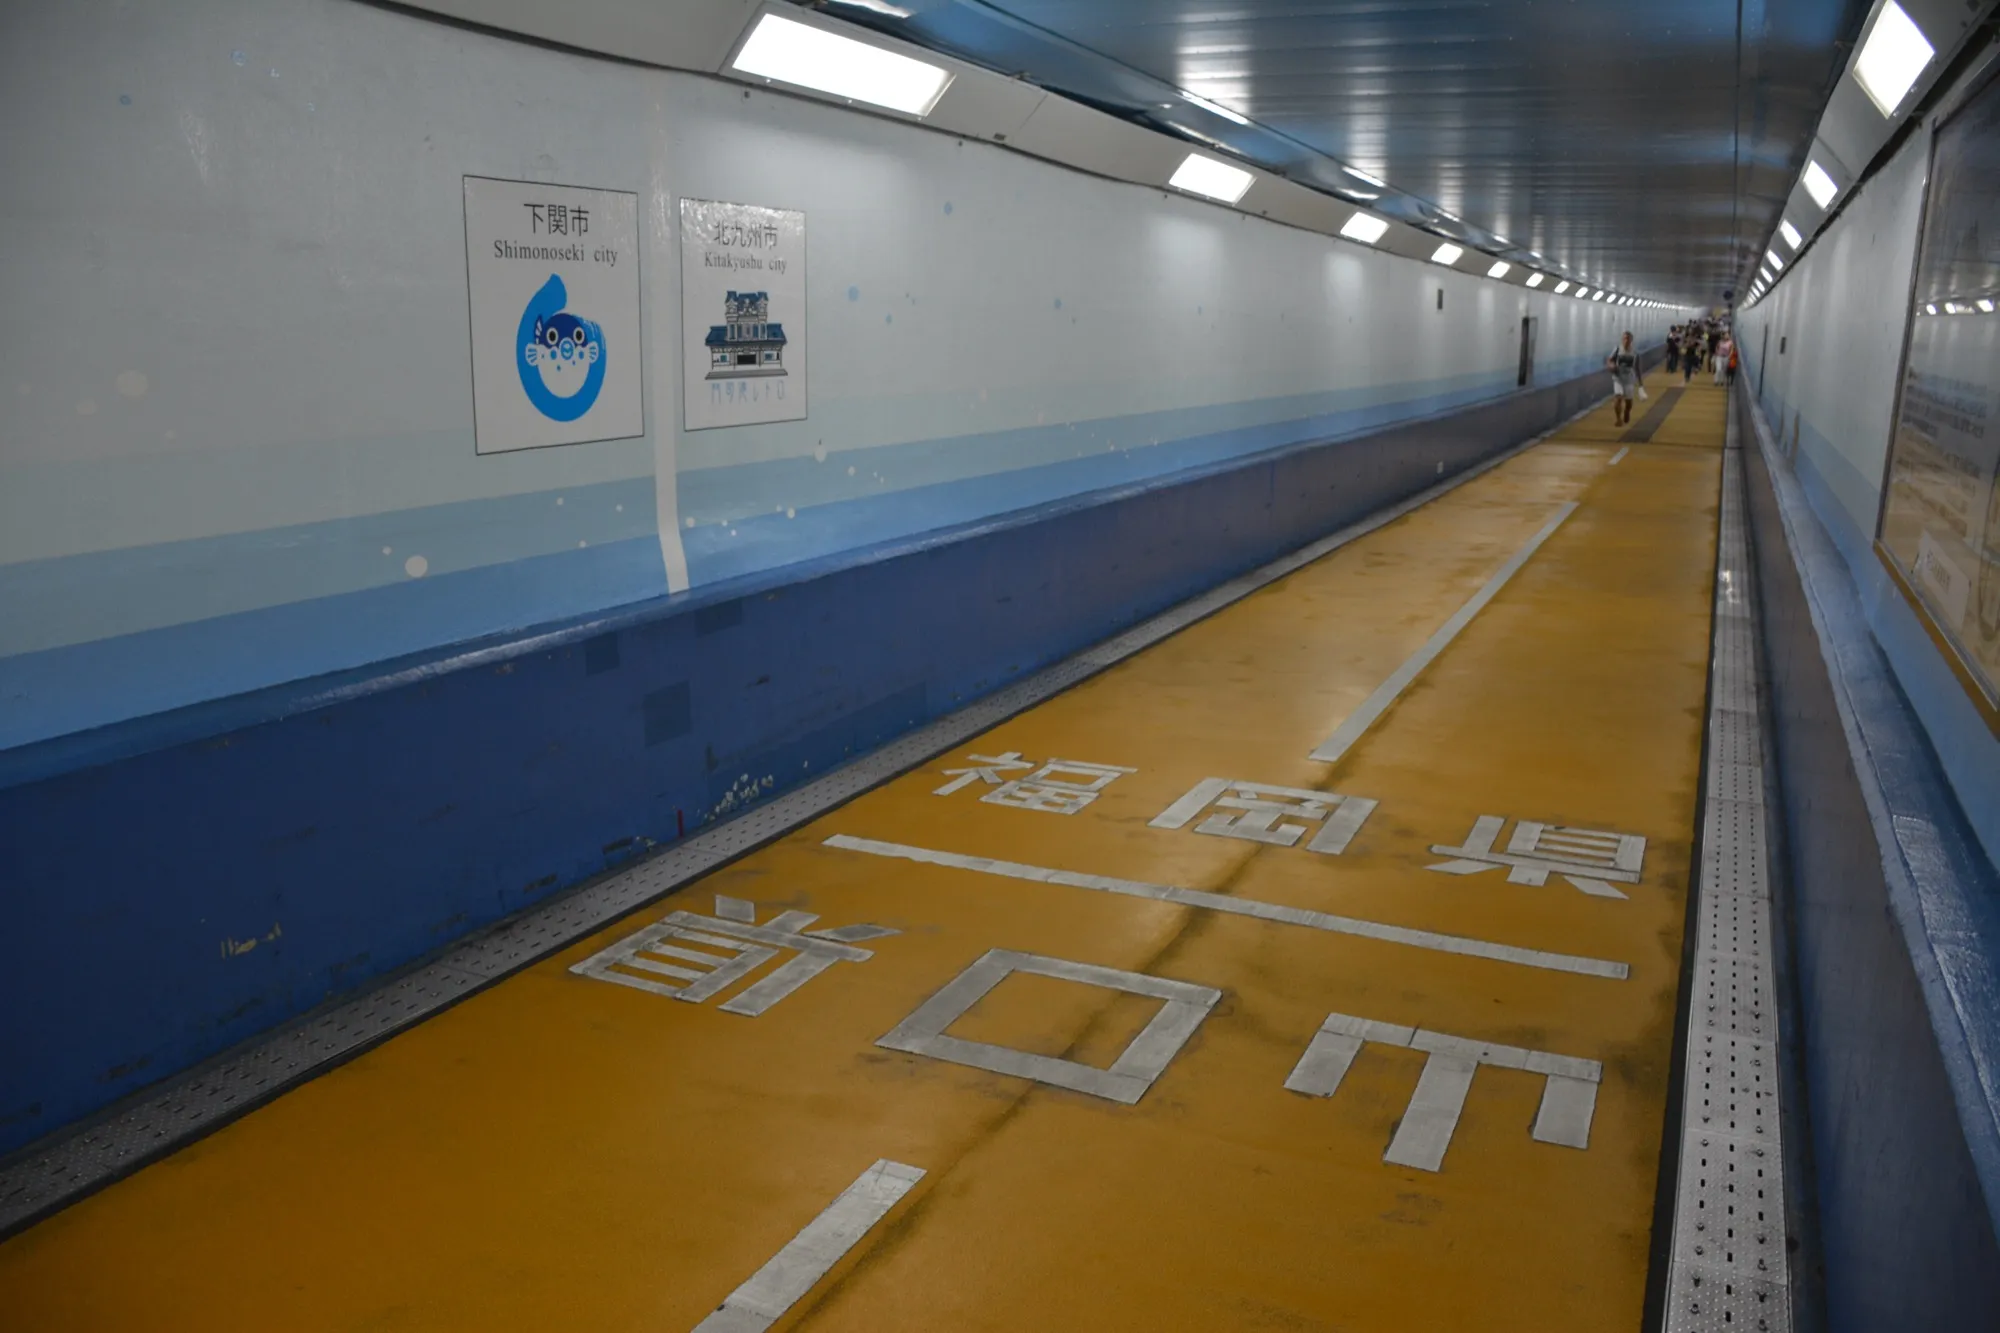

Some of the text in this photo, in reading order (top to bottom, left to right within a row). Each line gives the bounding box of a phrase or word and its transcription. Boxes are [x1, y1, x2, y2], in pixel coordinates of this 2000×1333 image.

[523, 203, 590, 237] 下関市
[713, 219, 778, 250] 北九州市
[494, 239, 618, 267] Shimonoseki city
[704, 251, 787, 275] Kitakyushu city
[932, 750, 1647, 900] 福岡県
[567, 894, 1604, 1173] 山口県
